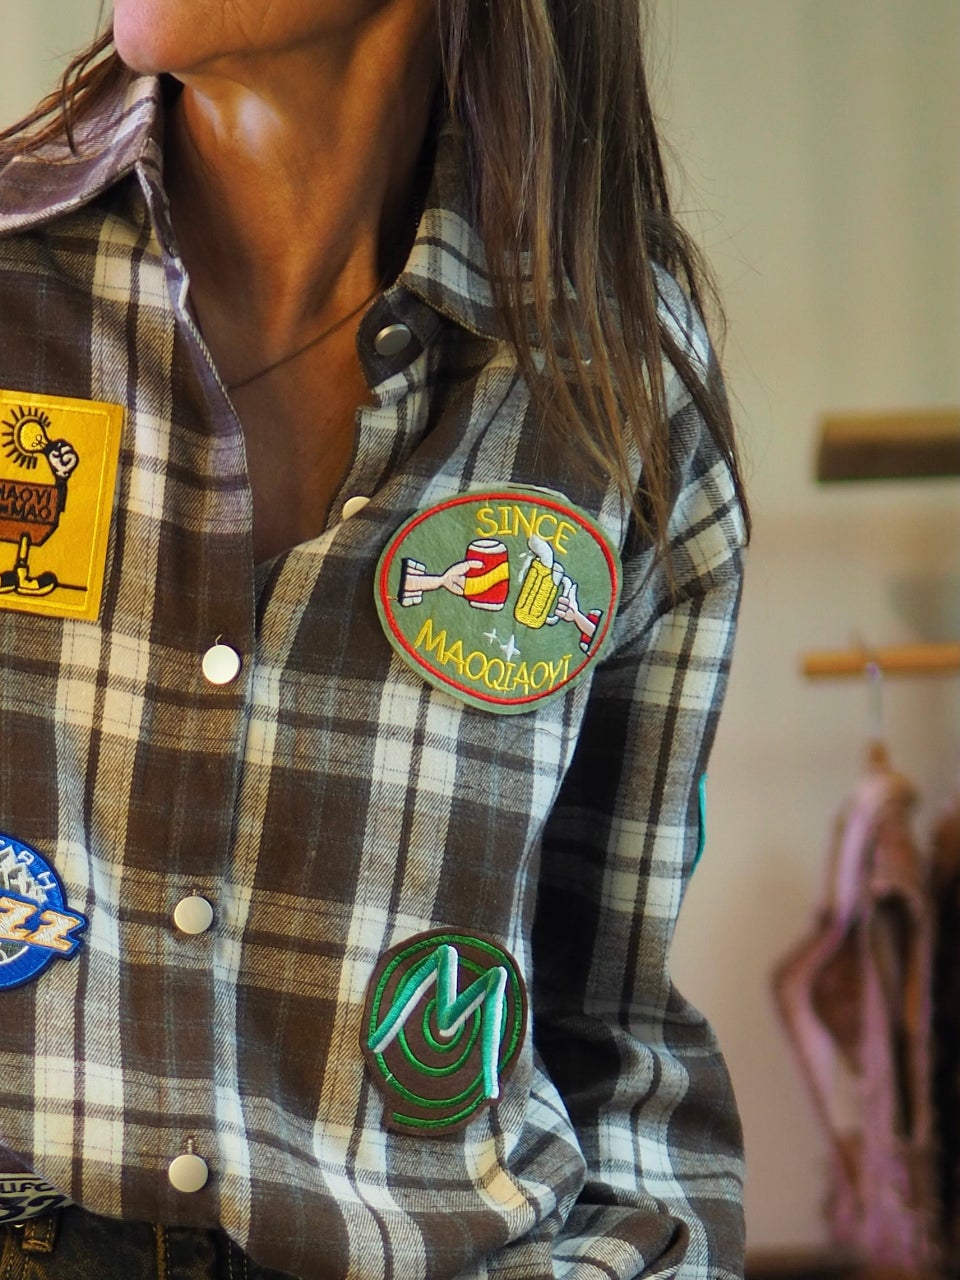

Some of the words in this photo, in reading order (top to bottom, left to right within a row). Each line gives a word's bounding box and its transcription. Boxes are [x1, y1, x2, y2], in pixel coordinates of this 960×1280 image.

[10, 500, 52, 521] MAO
[476, 505, 576, 554] SINCE
[414, 619, 572, 694] MAOQIAOYI
